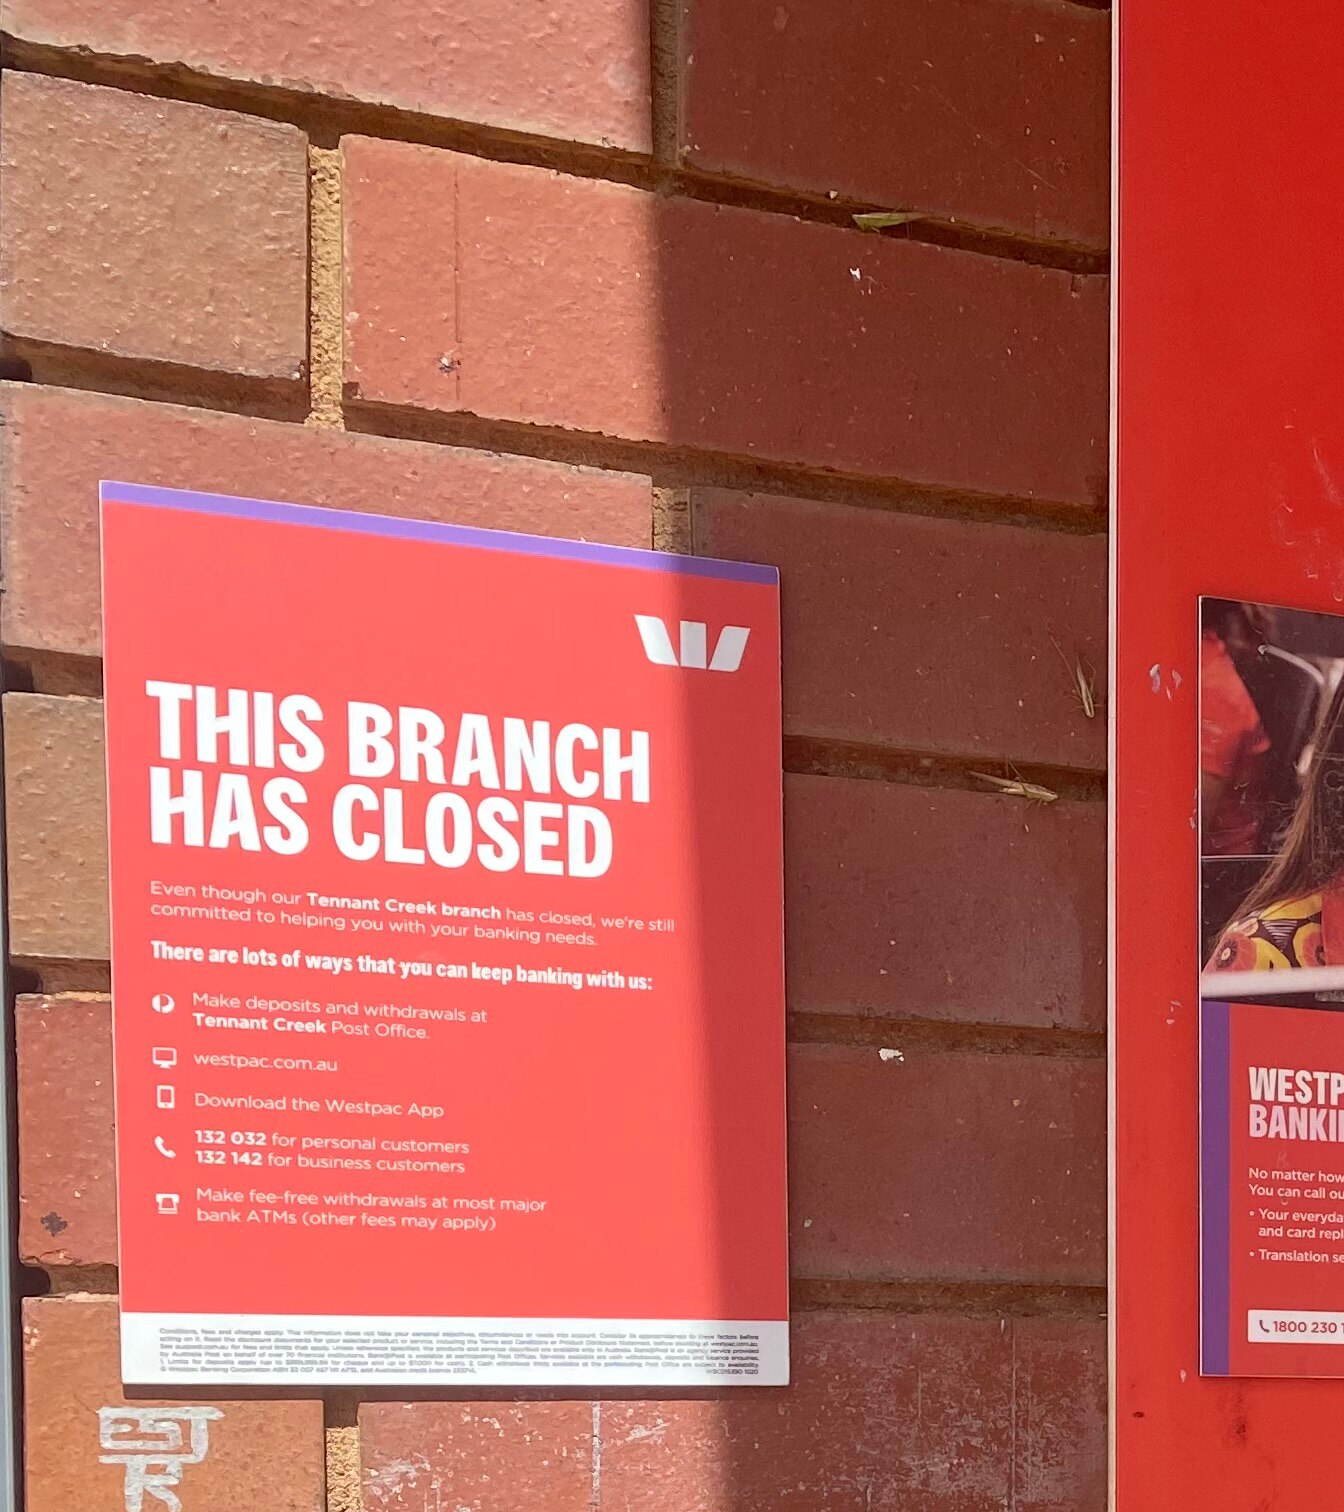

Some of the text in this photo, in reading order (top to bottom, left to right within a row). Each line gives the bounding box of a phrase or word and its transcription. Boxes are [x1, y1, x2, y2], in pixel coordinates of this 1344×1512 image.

[146, 680, 651, 803] THIS BRANCH
[149, 766, 613, 879] HAS CLOSED
[150, 880, 674, 931] Even though our Tennant Creek branch has closed, we're still
[150, 904, 596, 945] committed to helping you with your banking needs.
[151, 940, 652, 989] There are lots of ways that you can keep banking with us:
[192, 992, 487, 1022] Make deposits and withdrawals at
[192, 1012, 429, 1038] Tennant Creek Post Office.
[193, 1054, 337, 1071] westpac.com.au
[194, 1092, 444, 1118] Download the Westpac App
[194, 1129, 469, 1153] 132 032 for personal customers
[1248, 1167, 1268, 1179] No
[1271, 1169, 1315, 1181] matter
[1248, 1183, 1273, 1195] You
[1276, 1187, 1300, 1197] can
[1303, 1187, 1326, 1198] call
[1258, 1207, 1289, 1221] Your
[1258, 1225, 1283, 1236] and
[1286, 1227, 1315, 1238] card
[1273, 1320, 1307, 1332] 1800
[1310, 1321, 1337, 1333] 230
